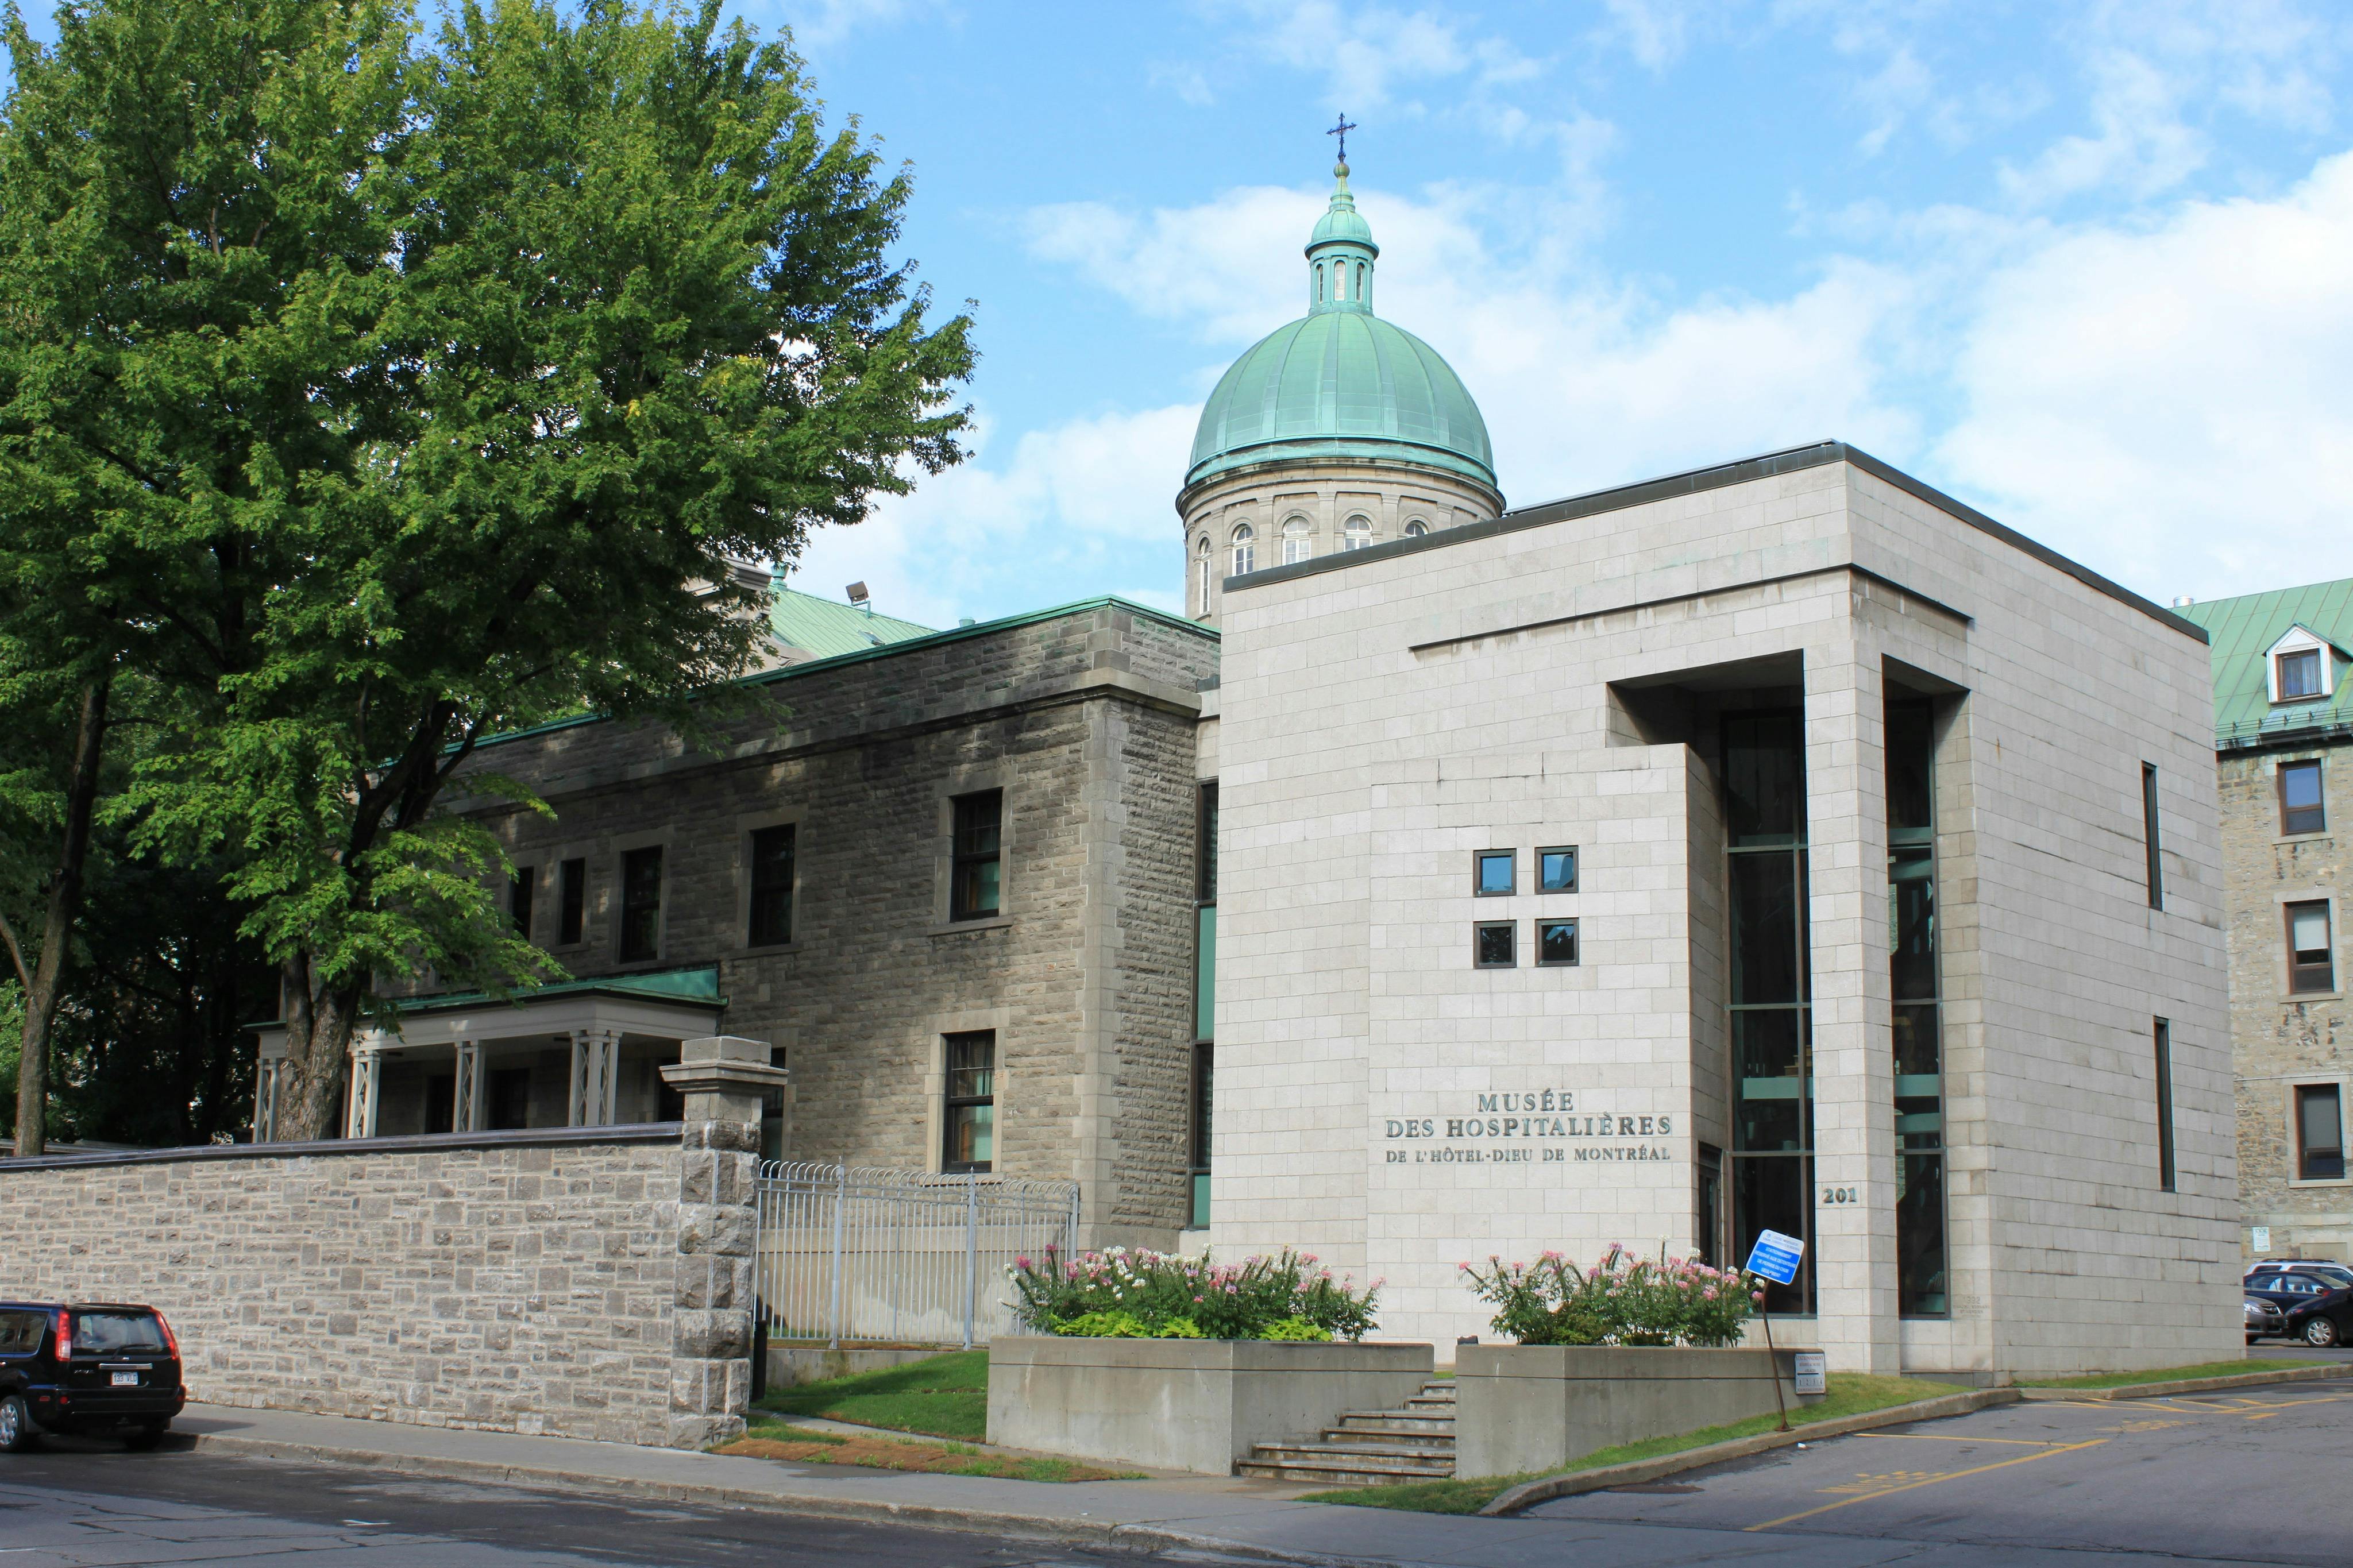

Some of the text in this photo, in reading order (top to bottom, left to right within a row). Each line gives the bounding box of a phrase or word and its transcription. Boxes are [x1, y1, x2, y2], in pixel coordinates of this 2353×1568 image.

[1478, 1087, 1573, 1112] MUSÉE
[1386, 1111, 1671, 1138] DES HOSPITALIÈRES
[1386, 1144, 1670, 1163] DE L'HÔTEL-DIEU DE MONTRÉAL
[1823, 1187, 1857, 1203] 201
